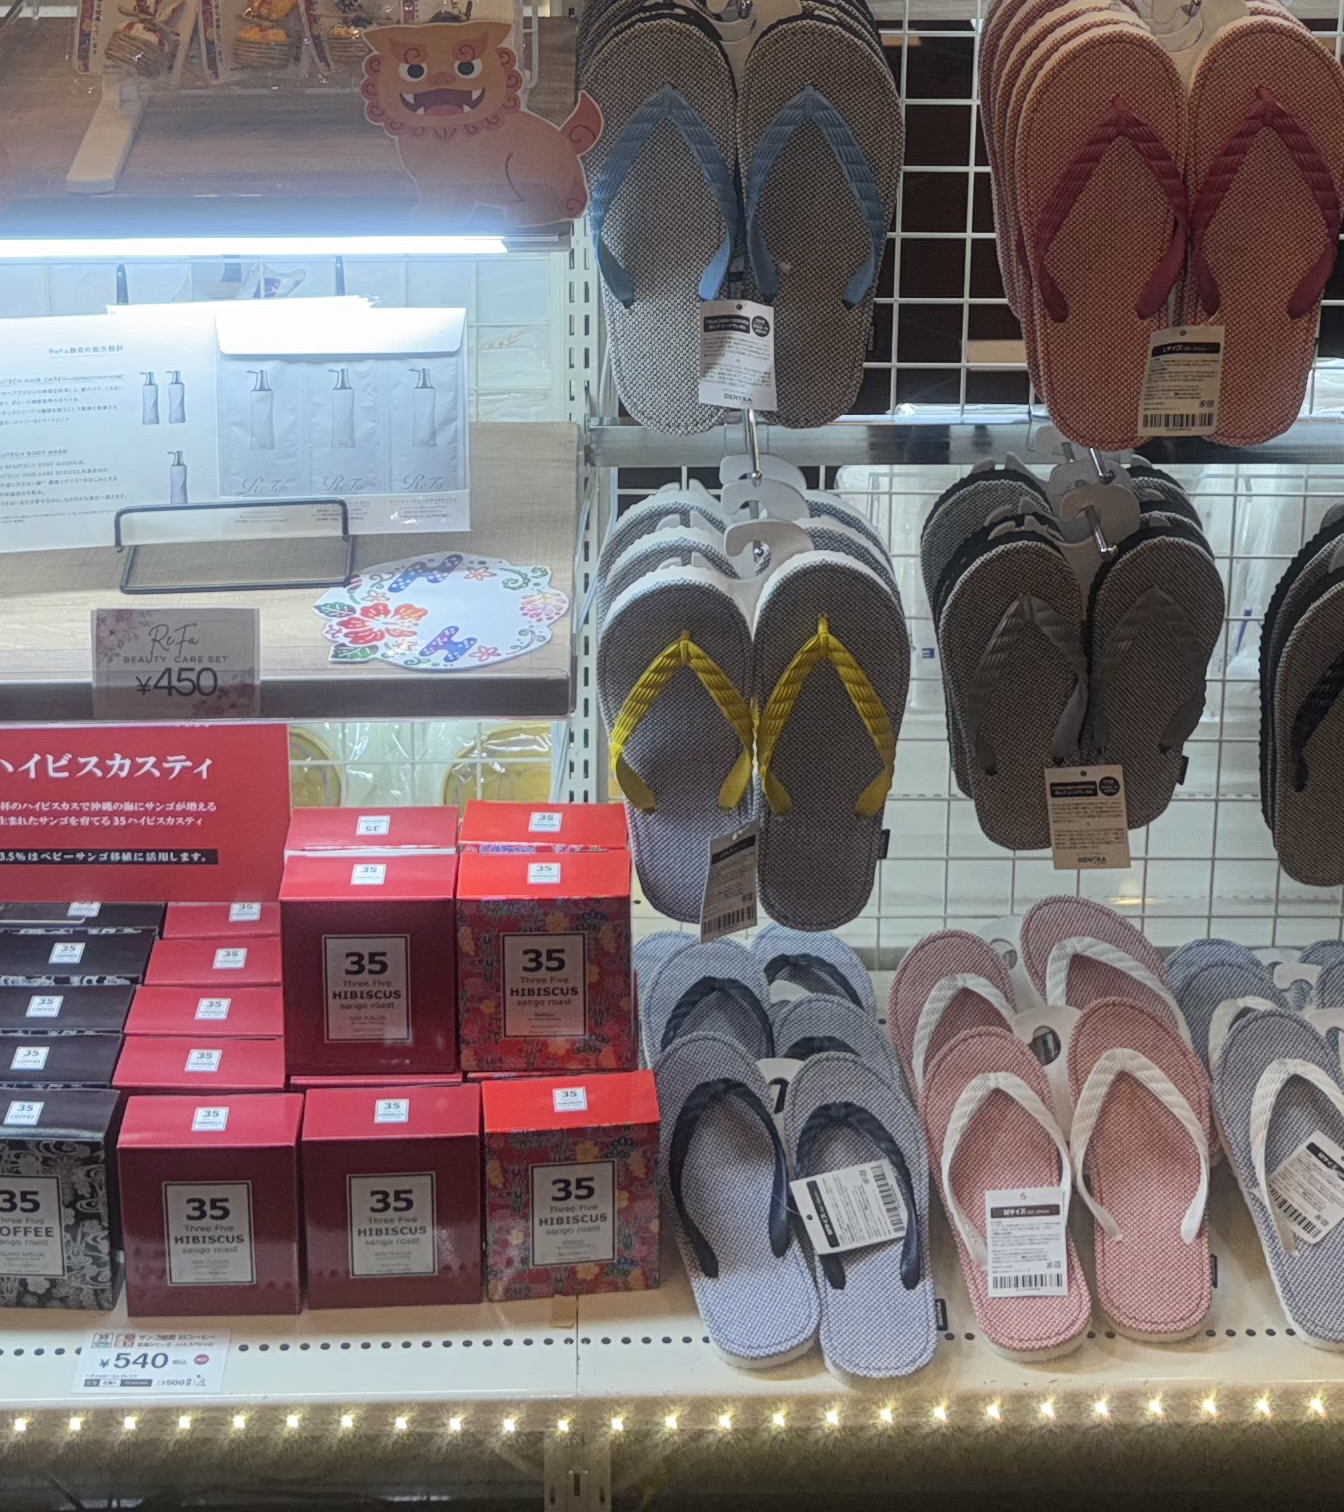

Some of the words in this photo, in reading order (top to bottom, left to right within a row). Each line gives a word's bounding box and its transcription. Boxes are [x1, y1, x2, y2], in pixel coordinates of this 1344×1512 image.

[123, 655, 167, 664] BEAUTY
[174, 655, 203, 664] CARE
[207, 655, 229, 663] SET
[135, 667, 218, 697] ¥450
[344, 951, 388, 975] 35
[521, 948, 566, 972] 35
[332, 989, 402, 1000] HIBISCUS
[510, 986, 579, 998] HIBISCUS
[206, 1000, 222, 1008] 35
[561, 1090, 578, 1098] 35
[17, 1103, 34, 1112] 35
[384, 1102, 401, 1110] 35
[202, 1110, 220, 1118] 35
[551, 1177, 595, 1201] 35
[369, 1189, 414, 1213] 35
[185, 1198, 230, 1221] 35
[538, 1213, 608, 1227] HIBISCUS
[357, 1225, 427, 1237] HIBISCUS
[174, 1234, 245, 1245] HIBISCUS
[99, 1352, 169, 1369] ¥540
